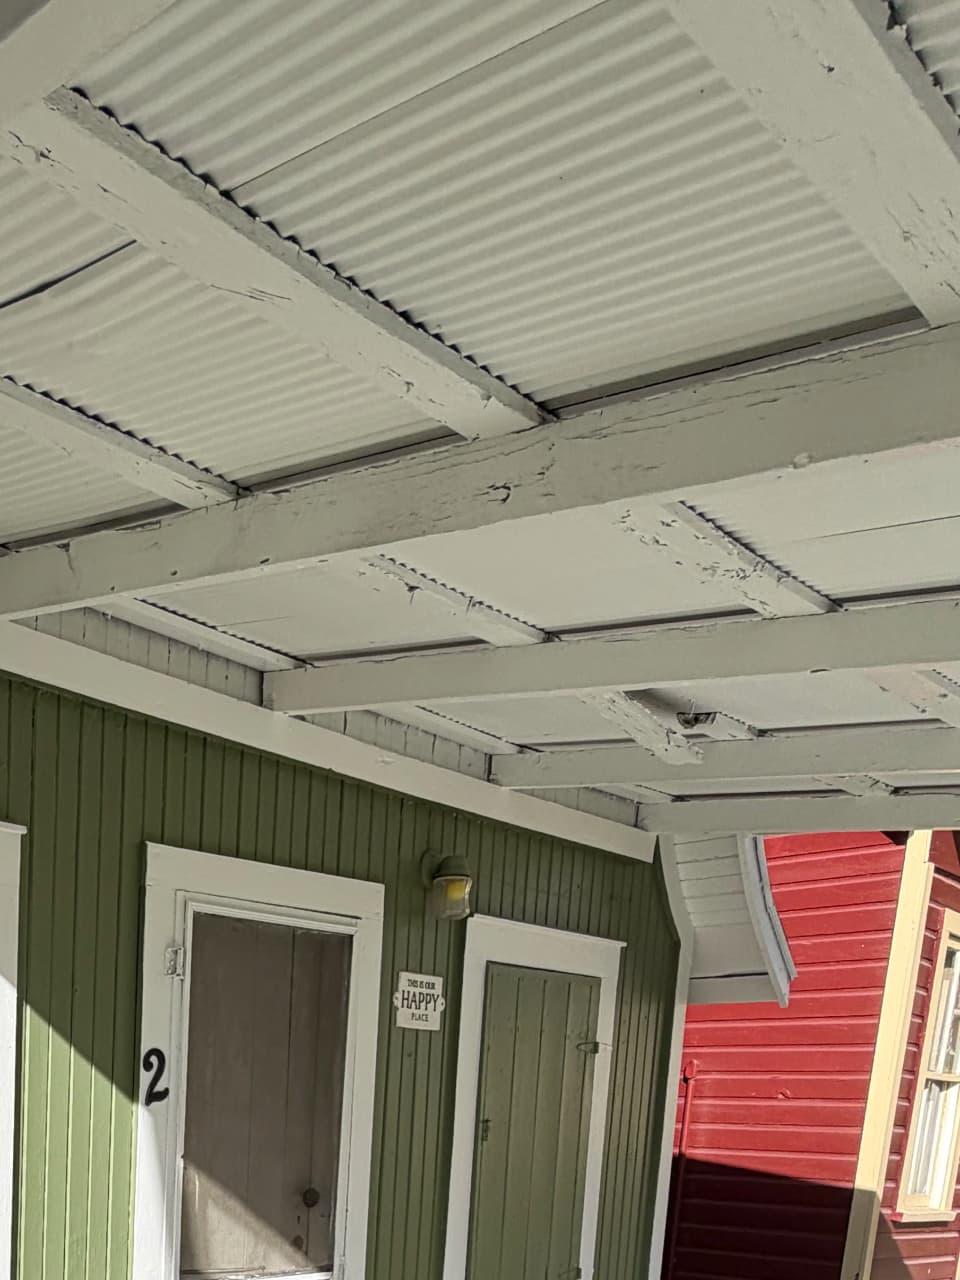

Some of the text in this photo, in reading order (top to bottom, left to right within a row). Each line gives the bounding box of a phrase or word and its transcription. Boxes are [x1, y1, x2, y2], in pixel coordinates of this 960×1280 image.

[407, 979, 418, 988] THIS
[419, 980, 424, 989] IS
[401, 989, 440, 1012] HAPPY
[411, 1012, 429, 1022] PLACE
[143, 1048, 170, 1107] 2
